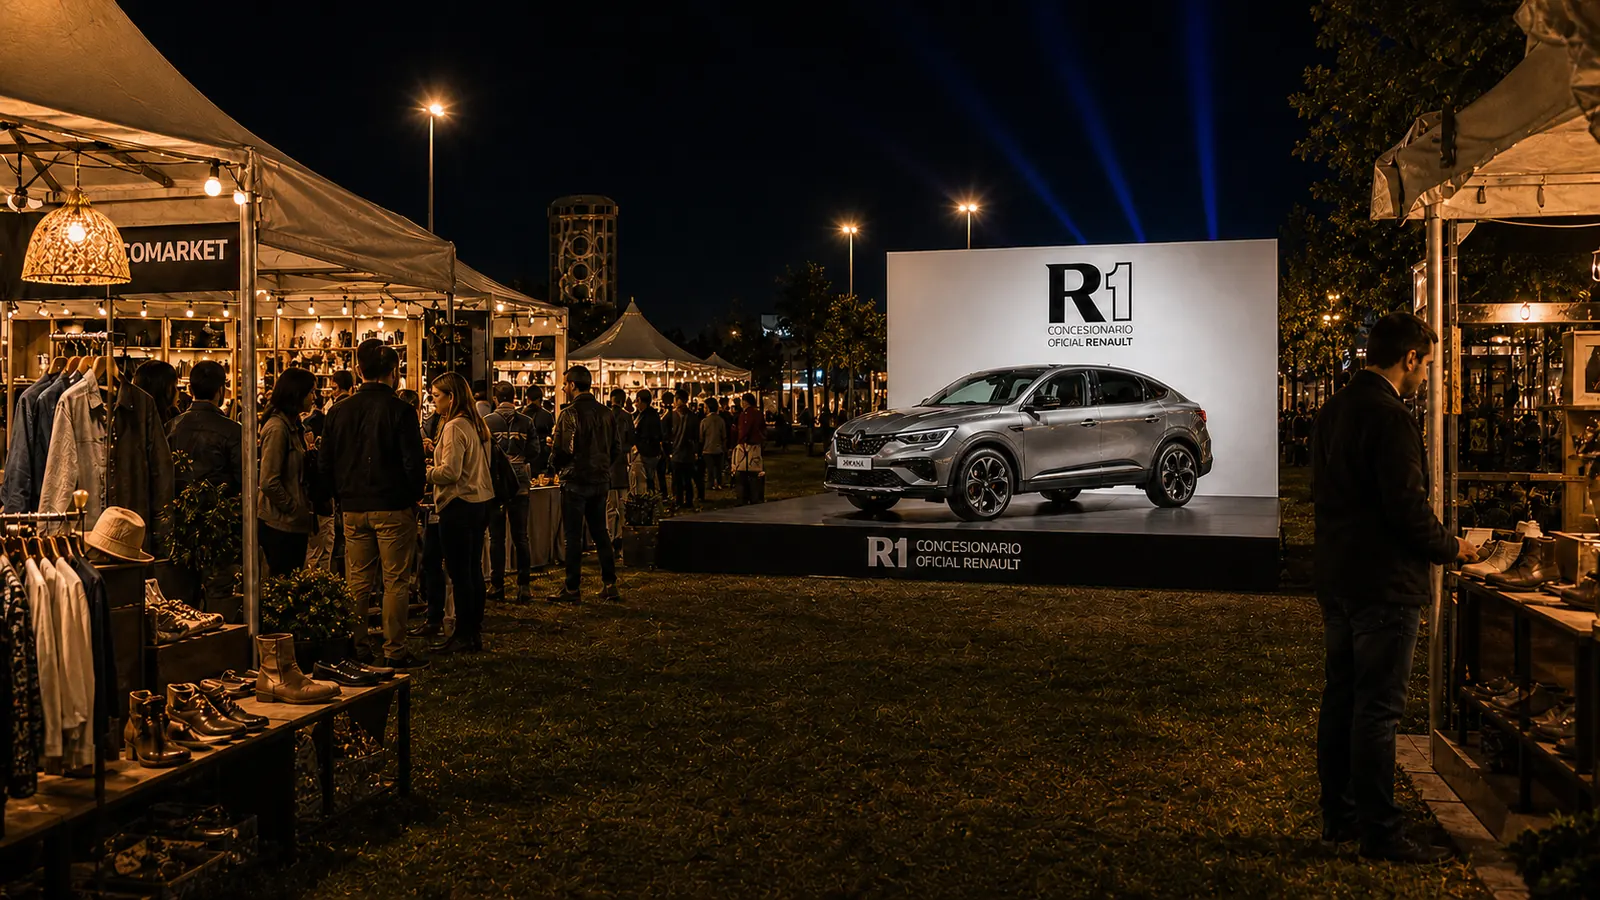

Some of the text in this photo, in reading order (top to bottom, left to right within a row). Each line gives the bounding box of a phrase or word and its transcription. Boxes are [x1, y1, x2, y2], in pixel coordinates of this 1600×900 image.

[1046, 262, 1132, 323] R1
[1047, 325, 1133, 336] CONCESIONARIO
[1047, 337, 1133, 348] OFICIAL RENAULT
[866, 536, 908, 569] R1
[915, 539, 1022, 555] CONCESIONARIO
[915, 555, 1022, 571] OFICIAL RENAULT
